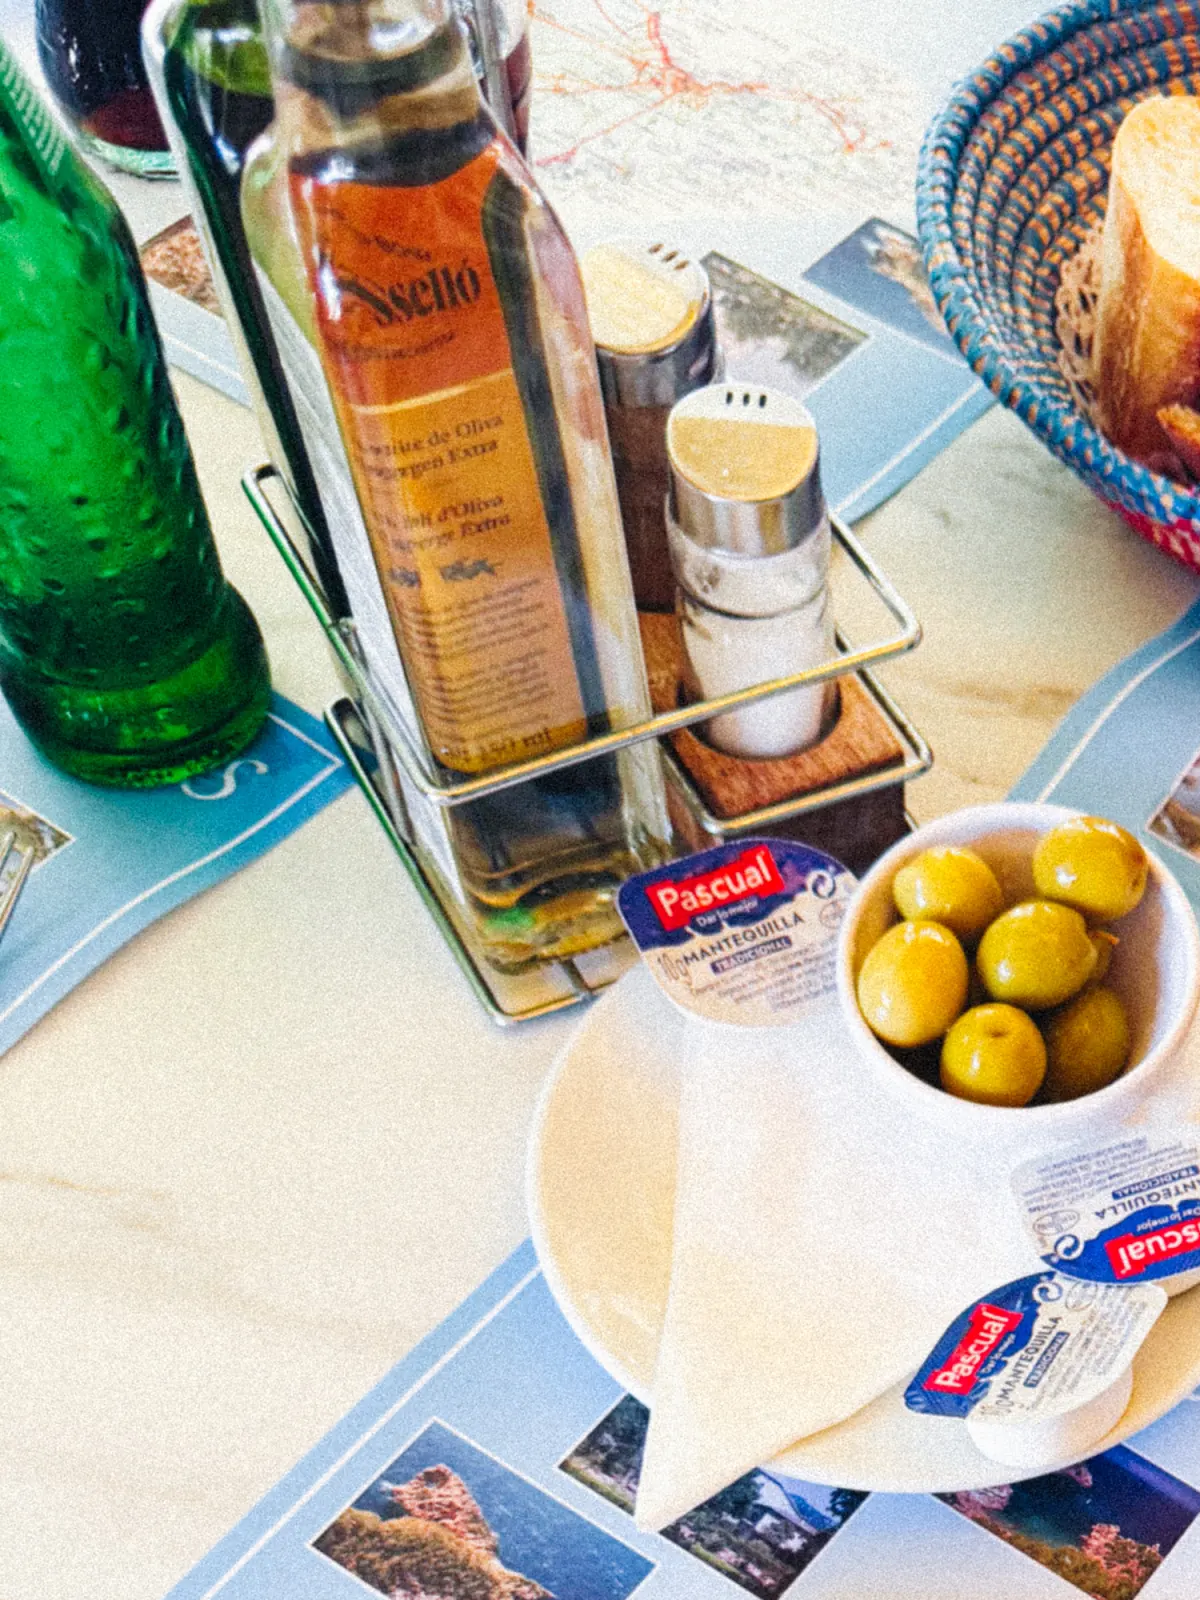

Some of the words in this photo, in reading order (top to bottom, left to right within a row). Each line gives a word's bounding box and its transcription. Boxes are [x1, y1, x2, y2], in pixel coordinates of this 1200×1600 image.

[454, 414, 504, 446] Oliva
[445, 437, 499, 471] Extra
[656, 855, 773, 918] Pascual
[684, 911, 806, 966] MANTEQUILLA
[715, 937, 791, 974] TRADICIONAL
[1113, 1164, 1200, 1200] TRADICIONAL
[1136, 1214, 1172, 1234] mejor
[934, 1305, 1010, 1389] Pascual
[996, 1315, 1063, 1402] MANTEQUILLA
[1025, 1331, 1069, 1387] TRADICIONAL
